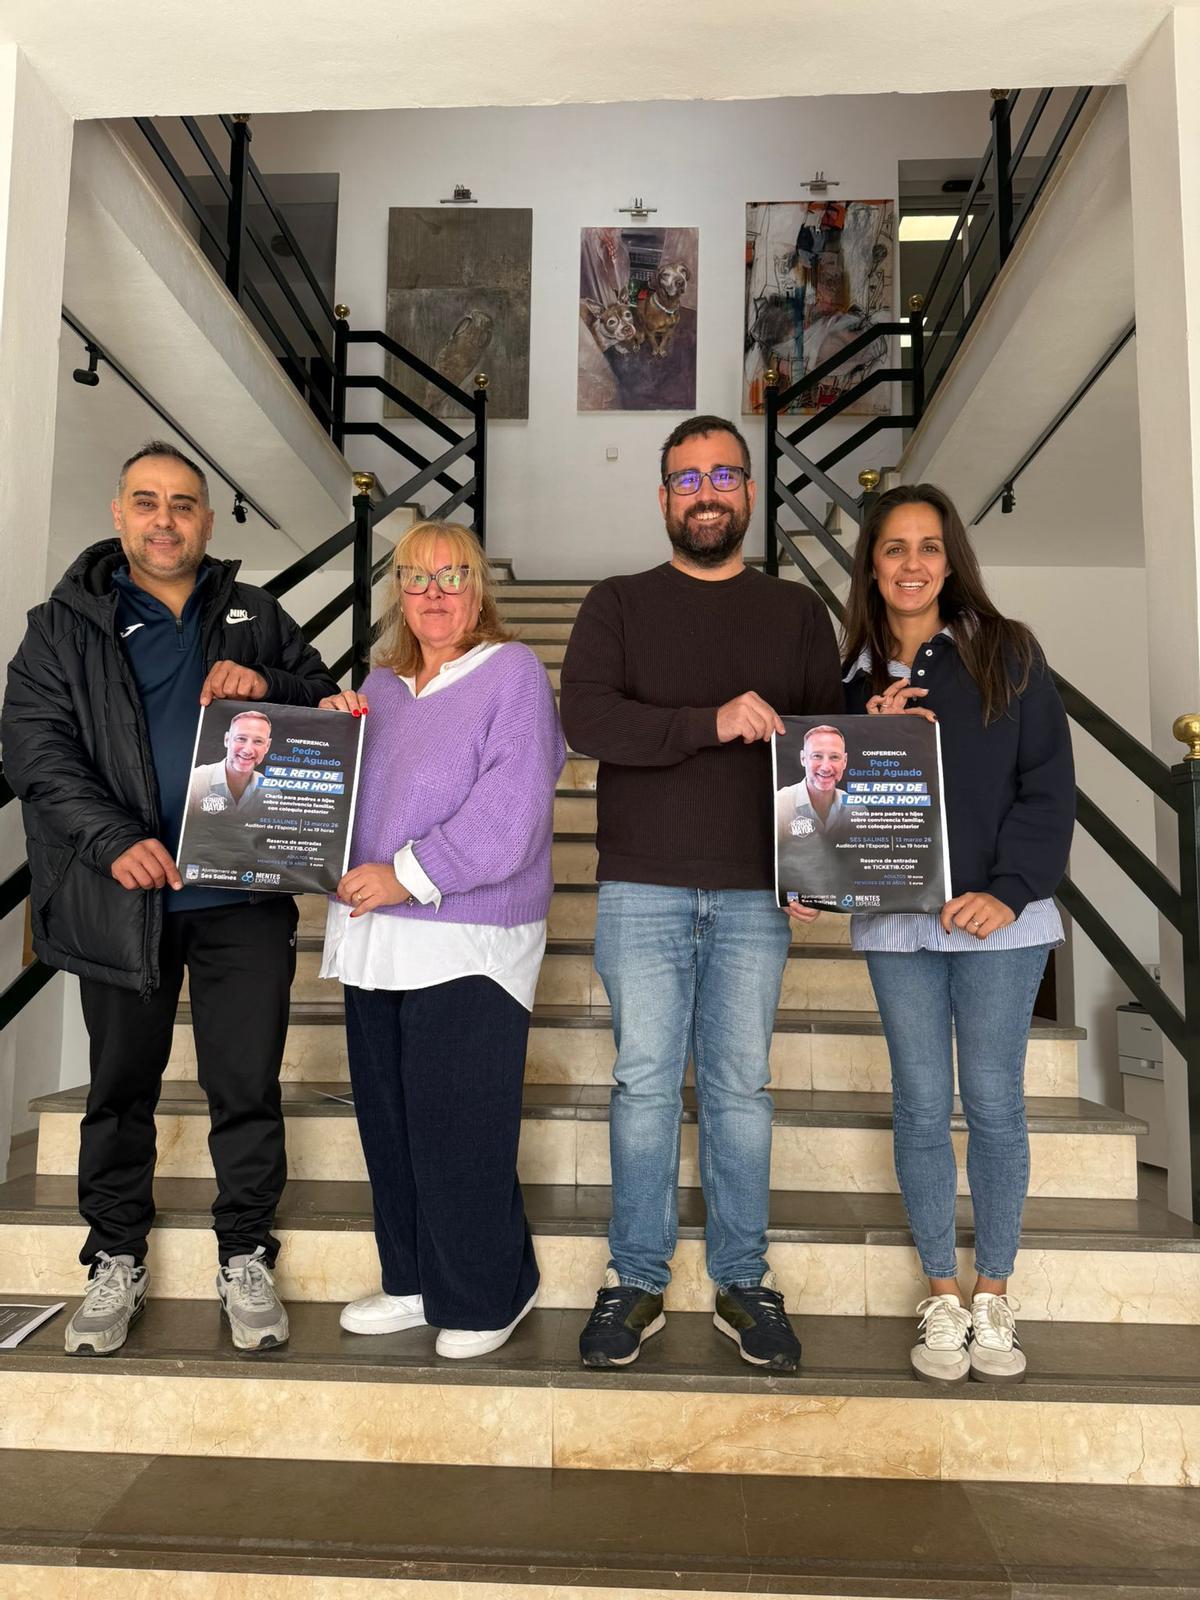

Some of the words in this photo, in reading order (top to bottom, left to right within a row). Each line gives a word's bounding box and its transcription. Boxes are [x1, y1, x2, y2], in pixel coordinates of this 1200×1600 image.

[286, 738, 330, 747] CONFERENCIA
[292, 747, 321, 756] Pedro
[270, 753, 300, 763] García
[303, 756, 341, 766] Aguado
[290, 769, 320, 779] RETO
[322, 772, 339, 780] DE
[849, 768, 880, 776] García
[883, 768, 922, 777] Aguado
[262, 779, 310, 790] EDUCAR
[873, 783, 904, 792] RETO
[906, 784, 922, 792] DE
[847, 795, 894, 804] EDUCAR
[203, 802, 224, 811] MAYOR
[792, 823, 813, 835] MAYOR
